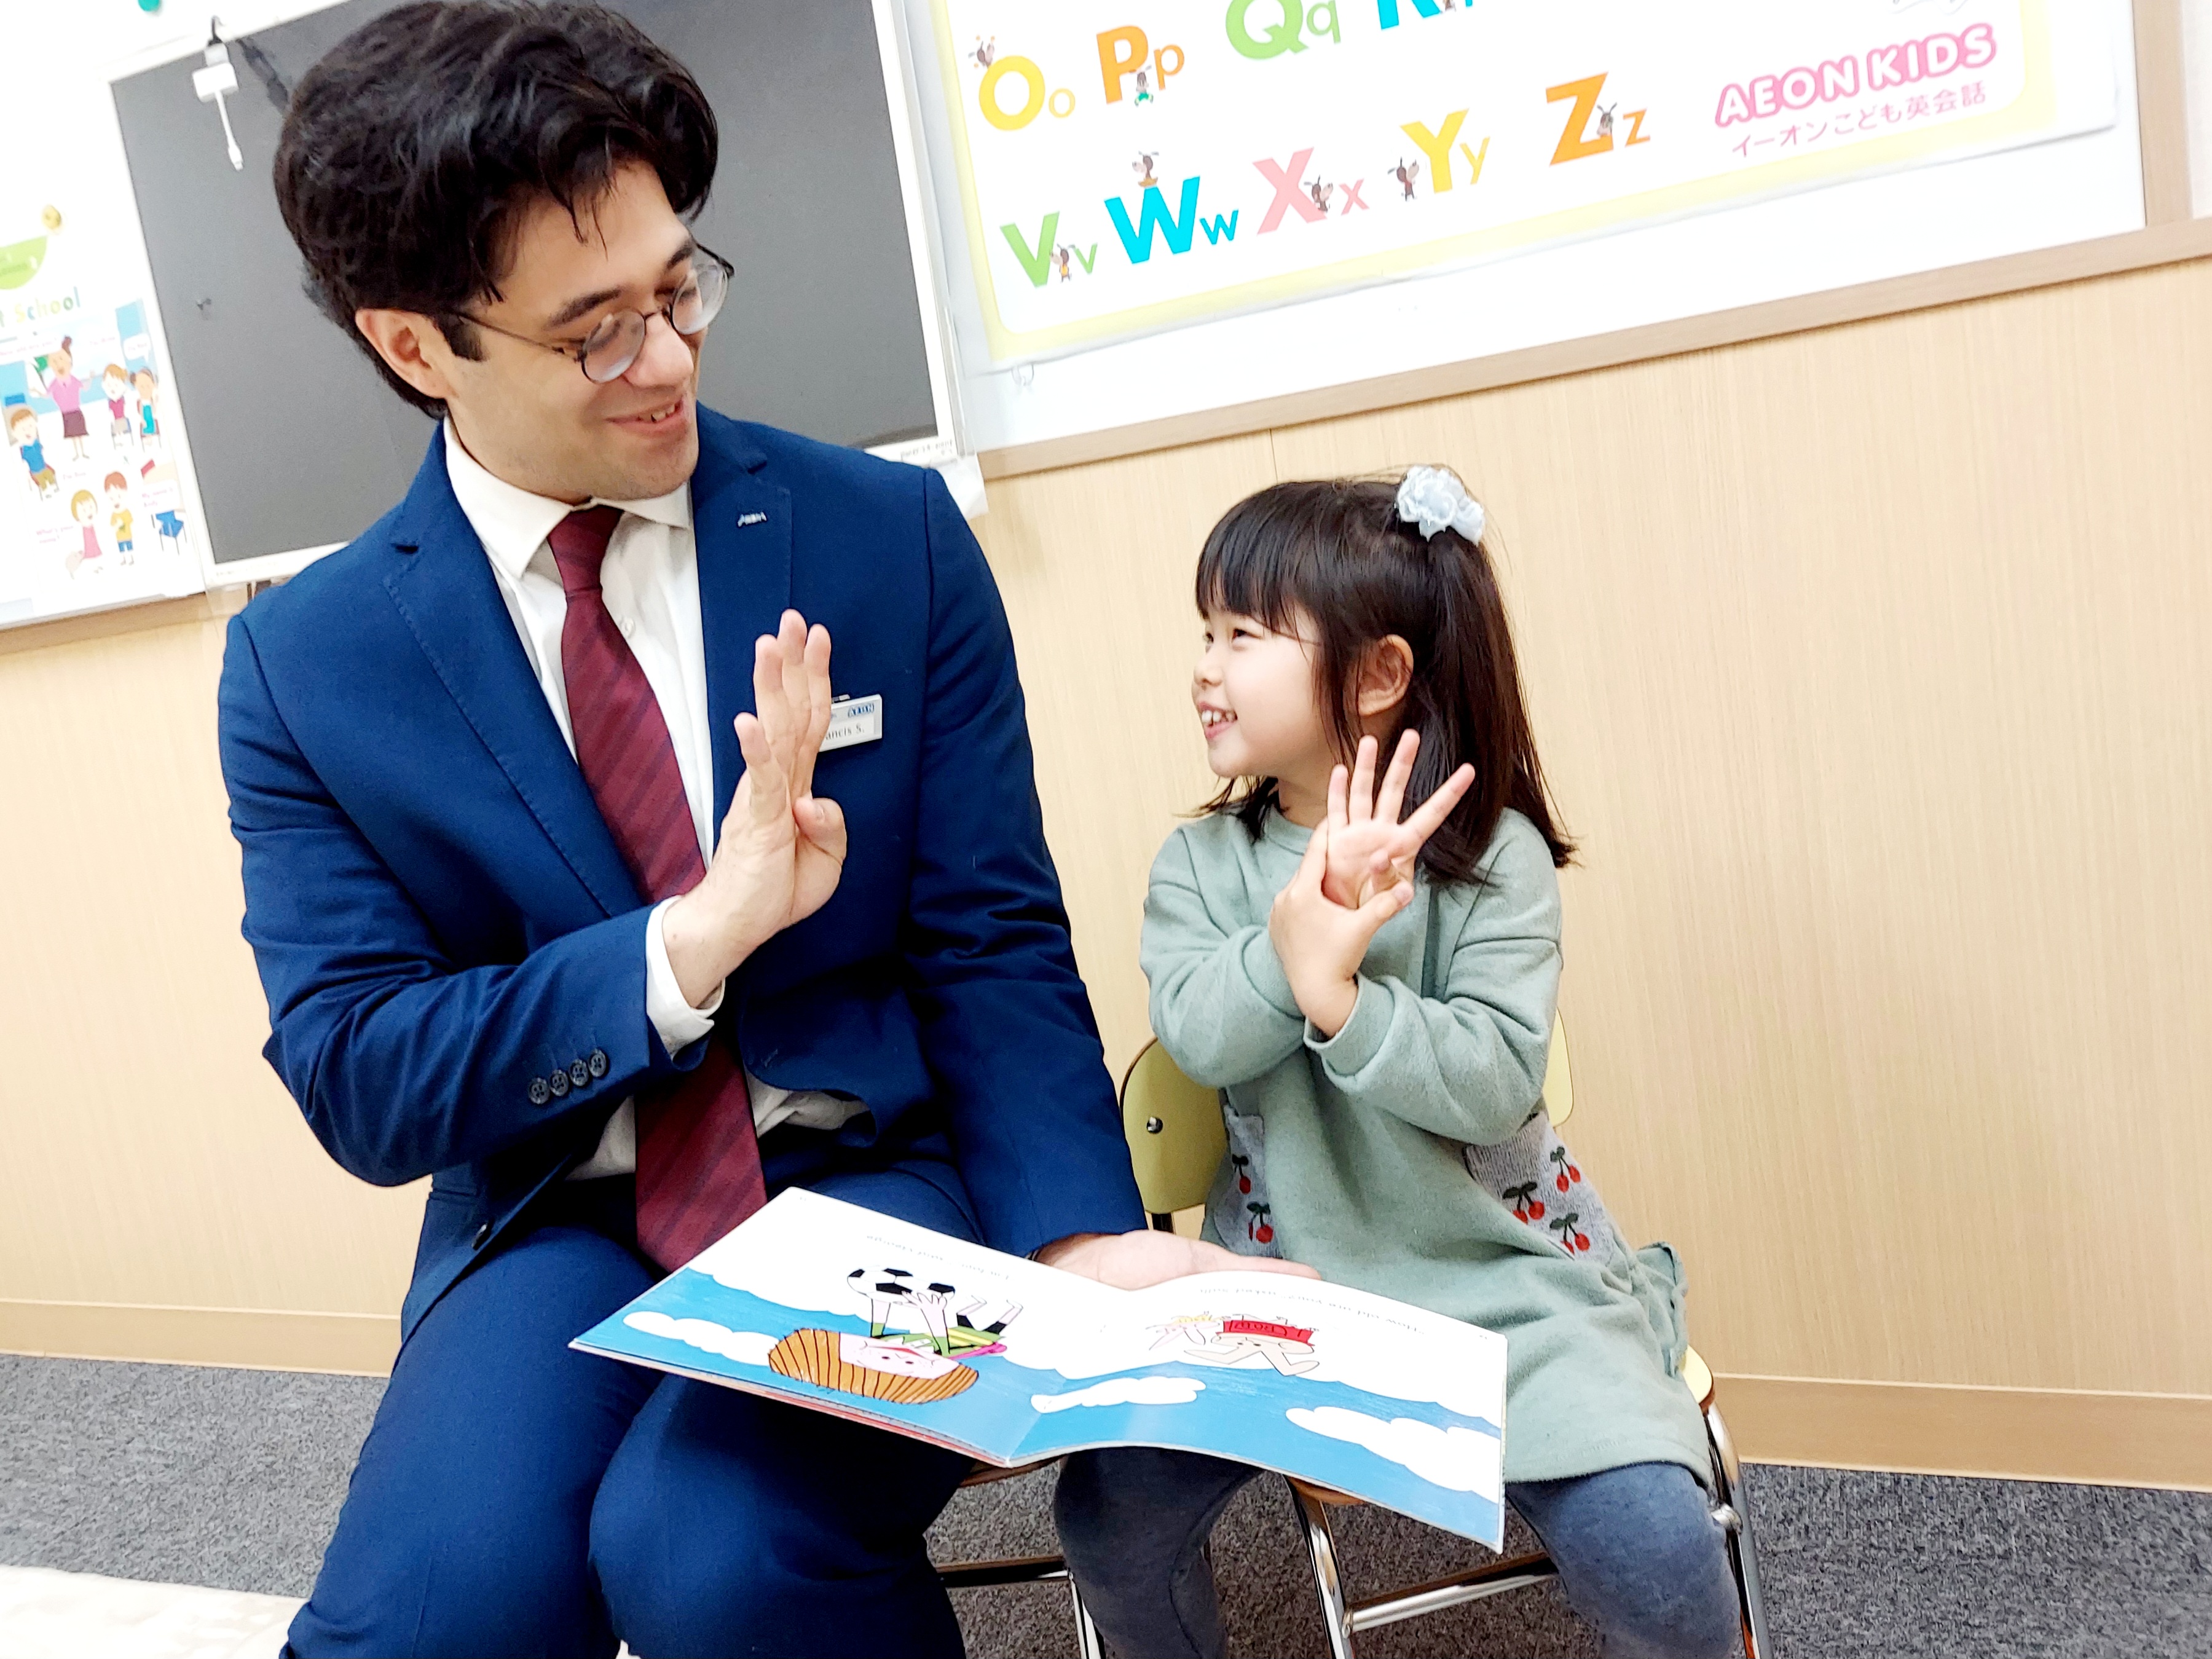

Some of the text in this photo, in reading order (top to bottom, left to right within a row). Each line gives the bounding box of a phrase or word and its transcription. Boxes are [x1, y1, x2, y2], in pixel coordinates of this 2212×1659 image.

[1715, 23, 1997, 127] AEON KIDS
[1732, 81, 1986, 158] イーオンこども英会話
[14, 286, 81, 323] School
[825, 727, 852, 740] ancis
